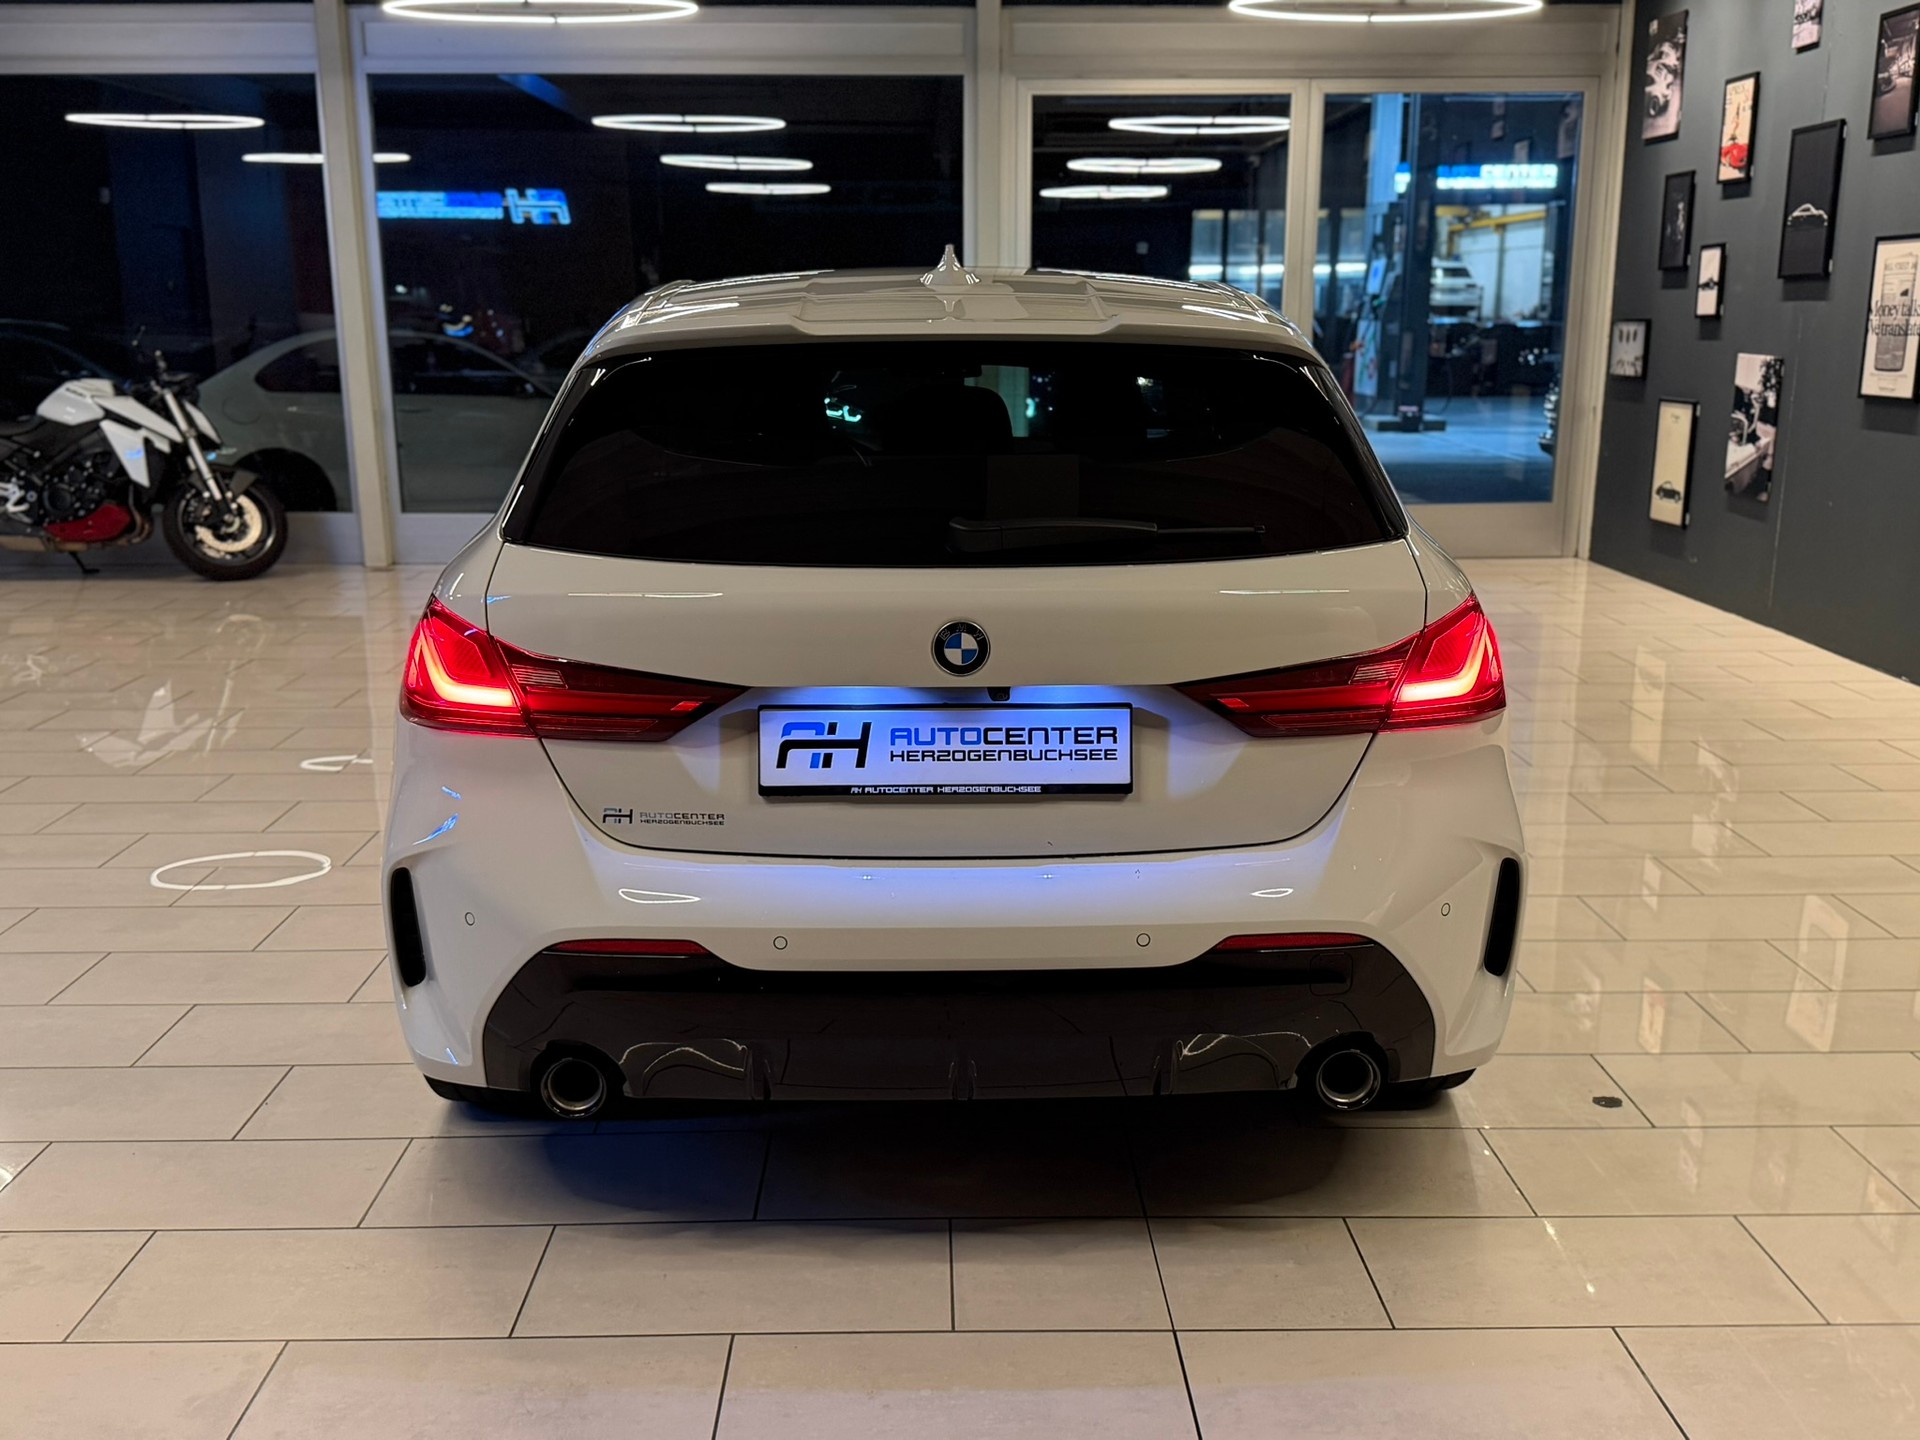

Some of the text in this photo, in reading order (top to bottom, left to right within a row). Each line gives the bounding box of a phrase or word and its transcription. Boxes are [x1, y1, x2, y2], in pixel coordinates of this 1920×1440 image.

[890, 727, 1118, 746] AUTOCENTER
[890, 749, 1118, 762] HERZOGENBUCHSEE
[864, 786, 934, 794] AUTOCENTER
[937, 785, 1042, 793] HERZOGENBUCHSEE
[640, 812, 725, 820] AUTOCENTER
